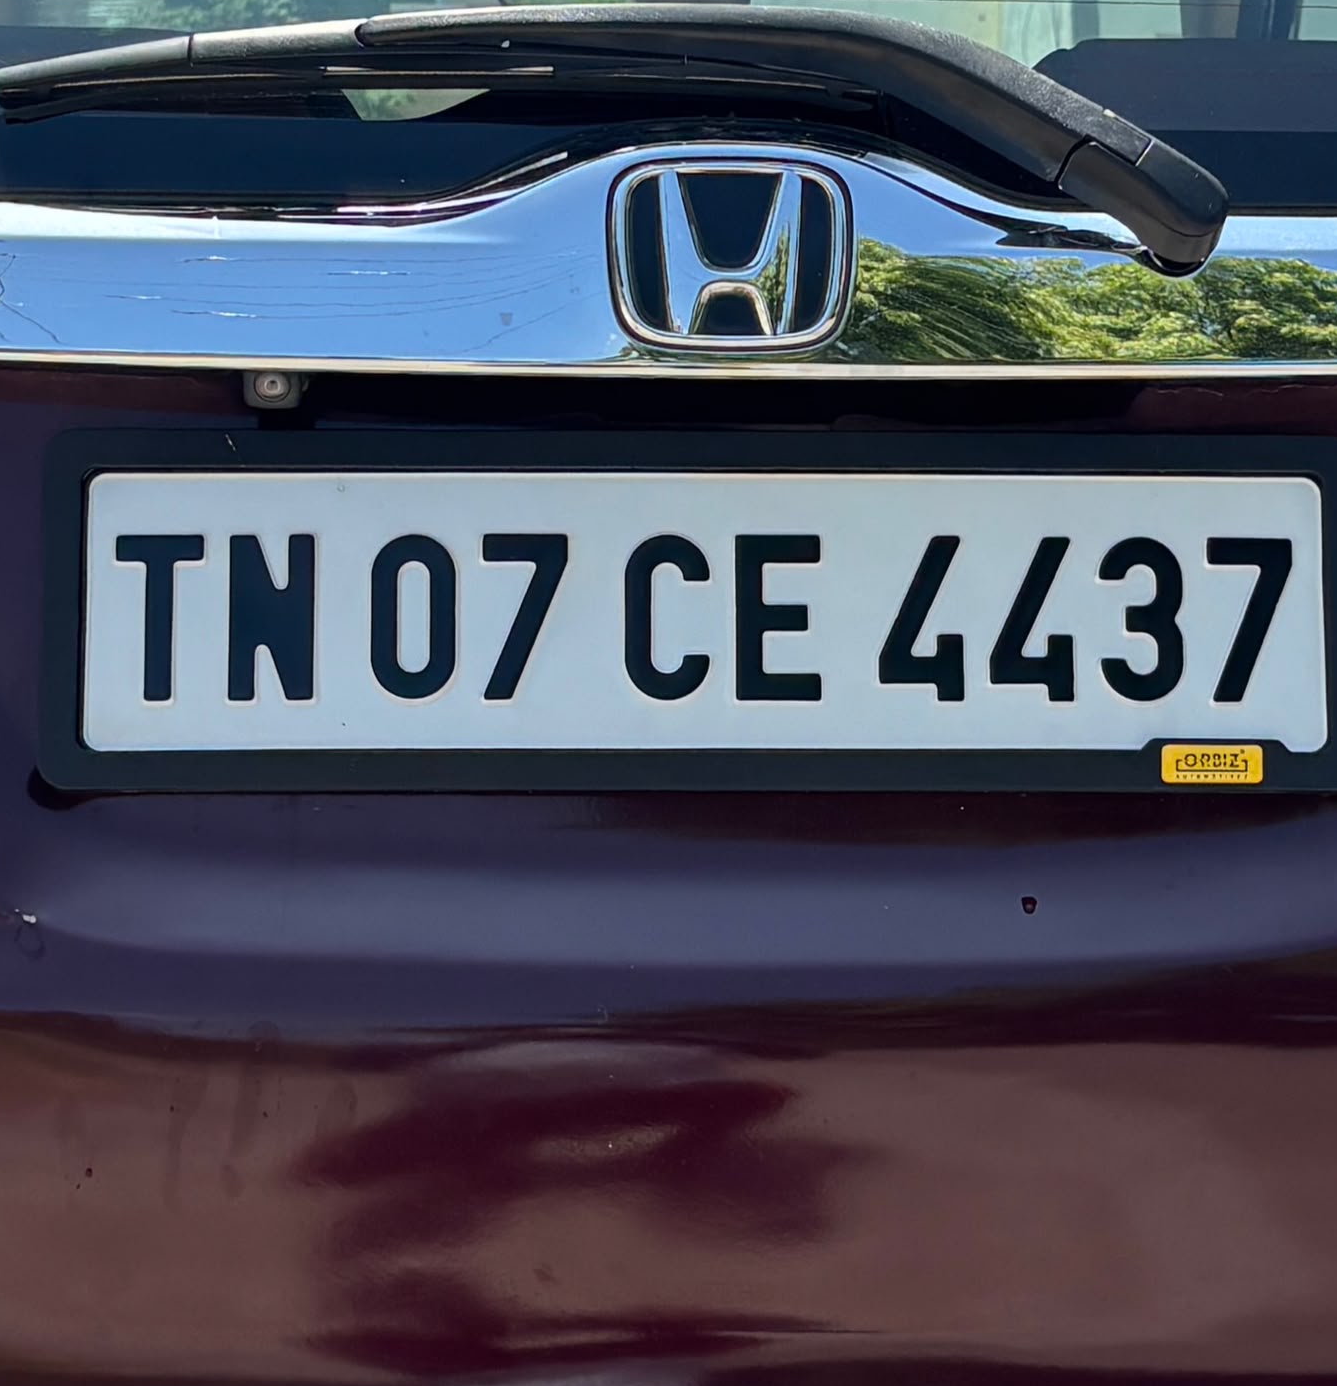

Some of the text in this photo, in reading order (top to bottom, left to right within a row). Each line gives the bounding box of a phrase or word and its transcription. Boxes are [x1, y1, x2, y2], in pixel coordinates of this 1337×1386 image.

[114, 533, 1294, 703] TN 07 CE 4437
